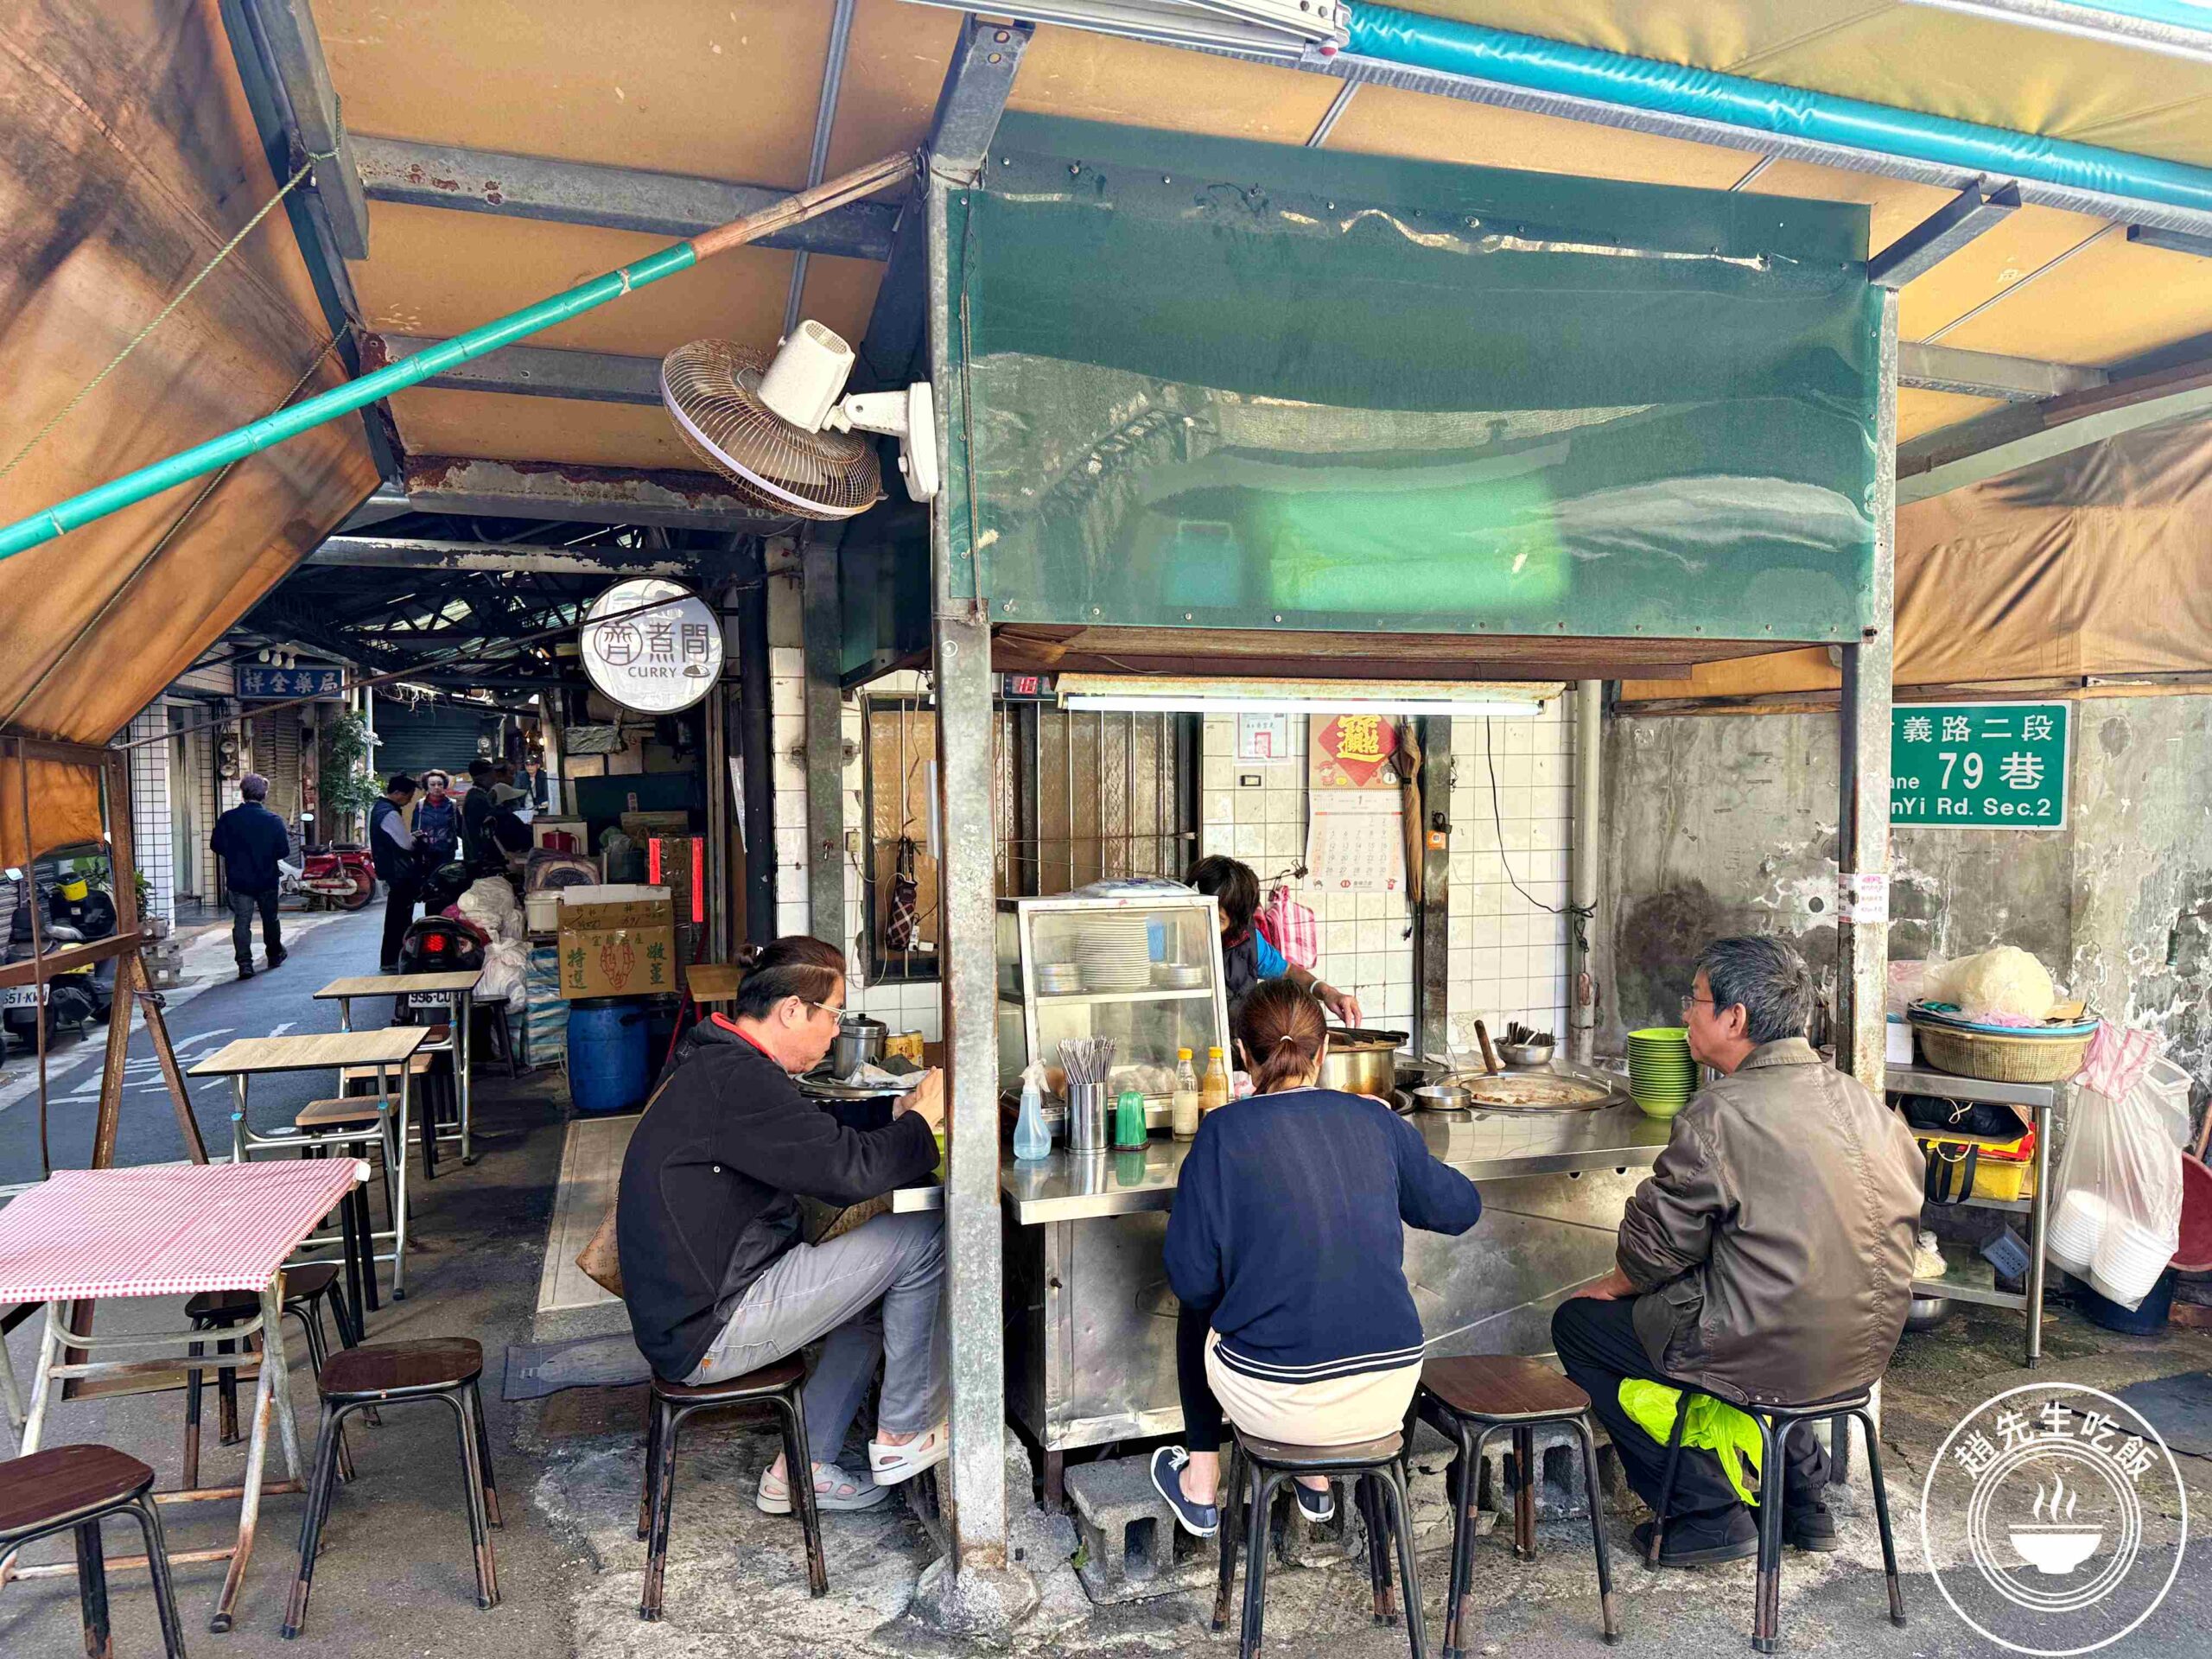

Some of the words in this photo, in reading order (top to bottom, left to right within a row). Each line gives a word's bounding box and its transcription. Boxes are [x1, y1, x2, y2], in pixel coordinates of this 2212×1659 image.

[628, 666, 677, 677] CURRY
[1891, 715, 2053, 743] 義路二段
[1937, 798, 1974, 815] Rd.
[1983, 798, 2050, 816] Sec.2
